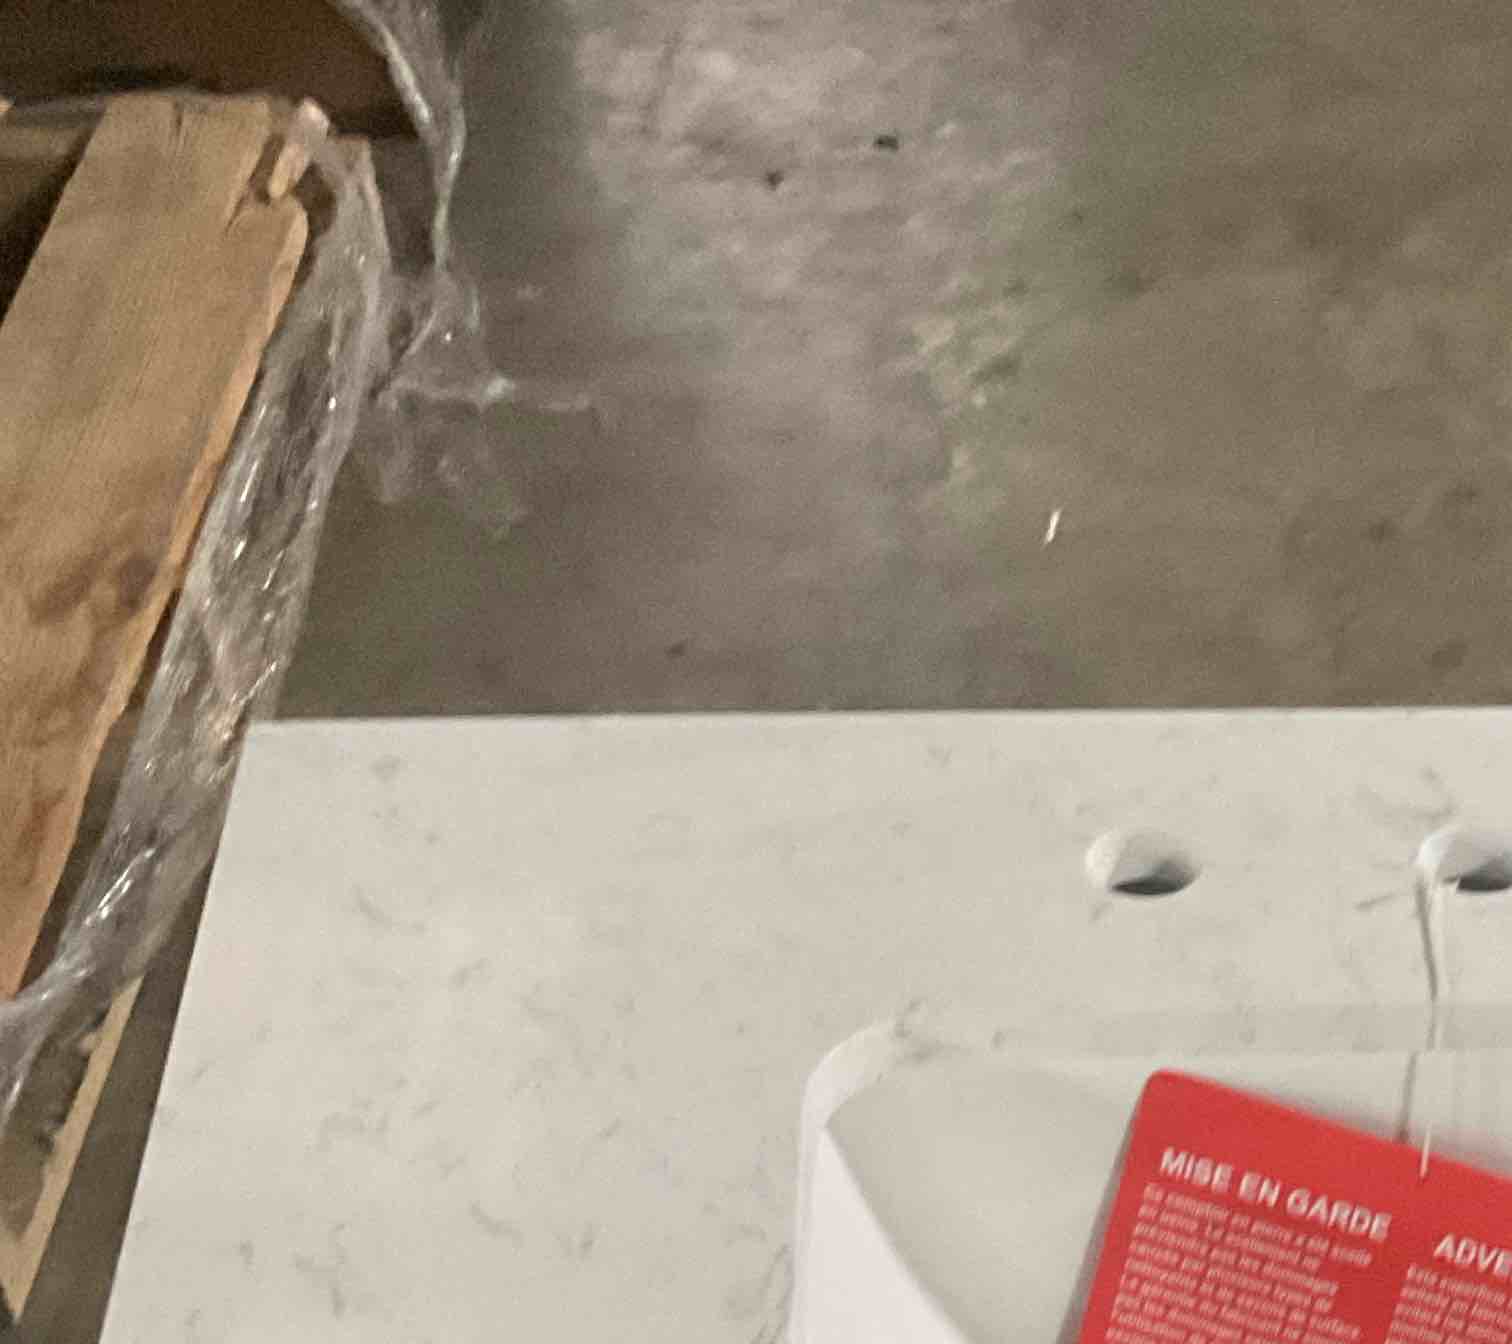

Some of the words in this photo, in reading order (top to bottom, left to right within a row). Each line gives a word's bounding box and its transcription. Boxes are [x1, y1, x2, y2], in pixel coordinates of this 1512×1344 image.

[1160, 1147, 1231, 1194] MISE
[1238, 1171, 1281, 1208] EN
[1286, 1188, 1392, 1240] GARDE
